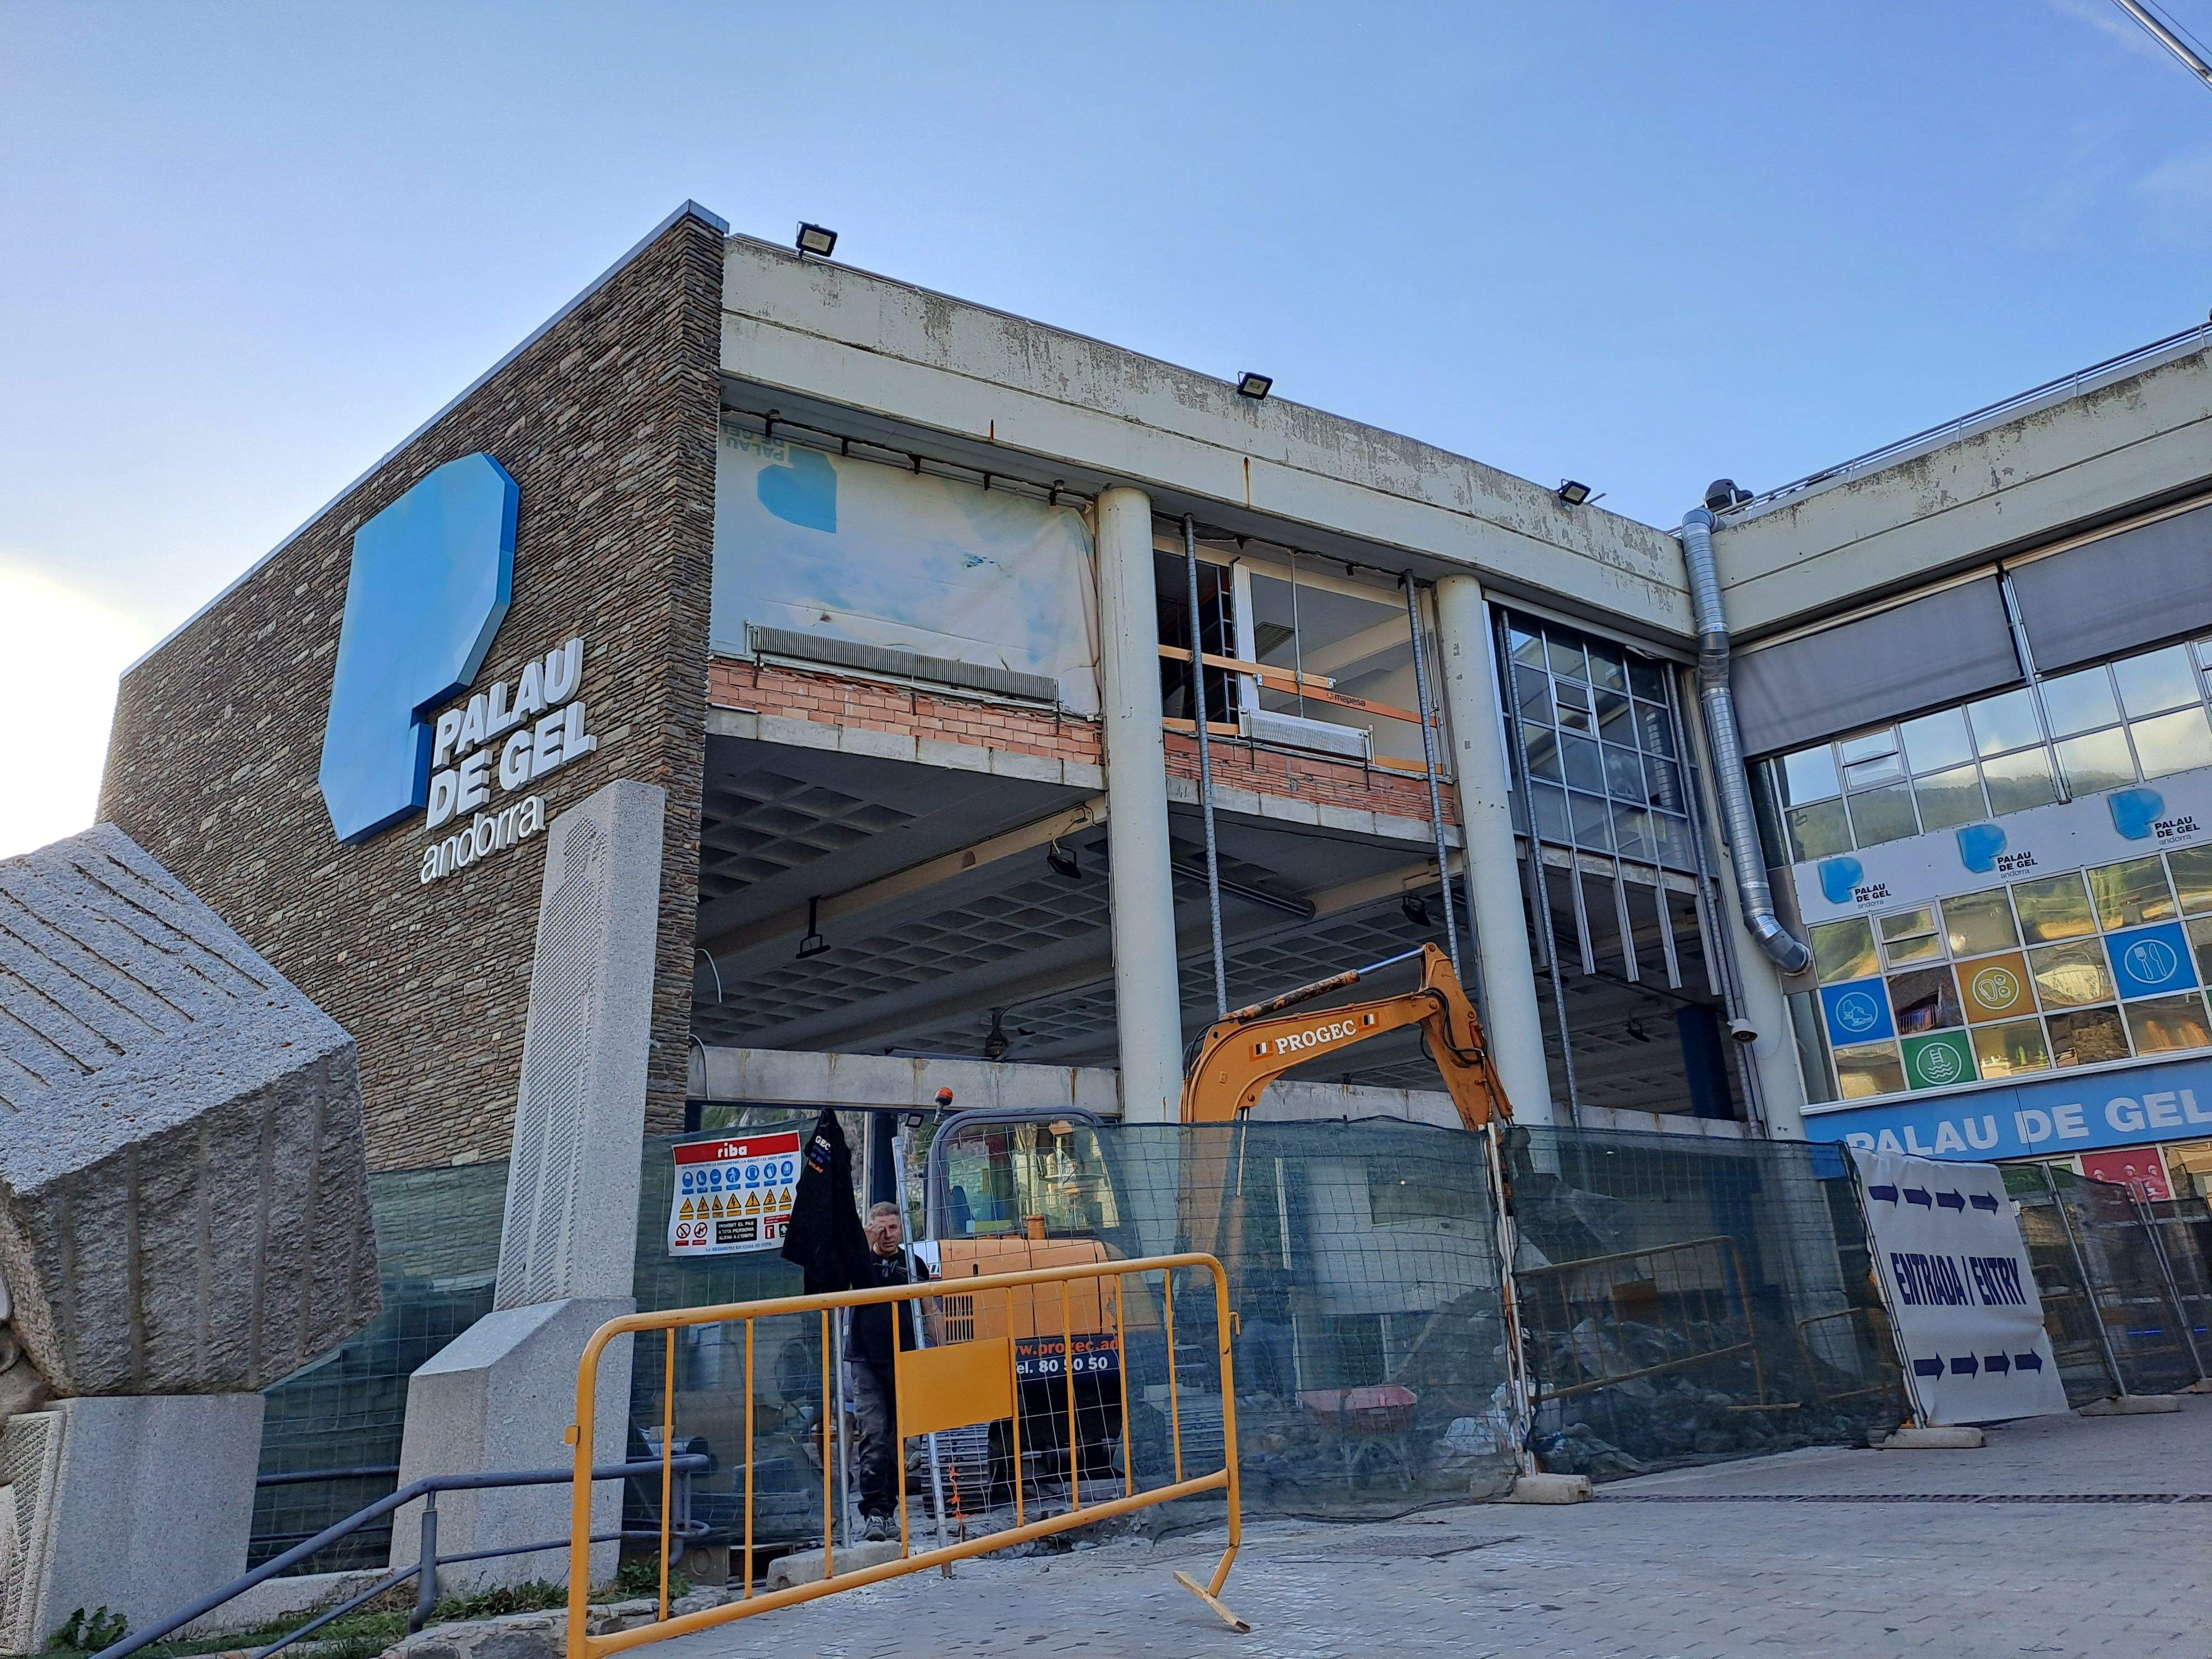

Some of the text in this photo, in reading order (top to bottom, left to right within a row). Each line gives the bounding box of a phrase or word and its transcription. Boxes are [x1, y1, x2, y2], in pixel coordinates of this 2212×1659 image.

[726, 436, 784, 462] PALAU
[432, 637, 585, 769] PALAU
[1334, 693, 1365, 707] mapesa
[426, 700, 598, 830] DE GEL
[2154, 816, 2193, 830] PALAU
[2157, 823, 2200, 838] DE GEL
[420, 795, 546, 885] andorra
[2159, 834, 2192, 845] andorra
[1997, 851, 2031, 864] PALAU
[1999, 858, 2038, 872] DE GEL
[2000, 869, 2030, 879] andorra
[1854, 883, 1885, 895] PALAU
[1856, 890, 1891, 902] DE GEL
[1858, 900, 1885, 909] andorra
[1275, 1019, 1357, 1055] PROGEC
[2015, 1103, 2089, 1144] DE
[2105, 1088, 2212, 1133] GEL
[718, 1142, 747, 1158] riba
[1890, 1253, 1969, 1305] ENTRADA
[1969, 1256, 2027, 1305] ENTRY
[1039, 1359, 1058, 1373] 80
[1088, 1357, 1108, 1370] 50
